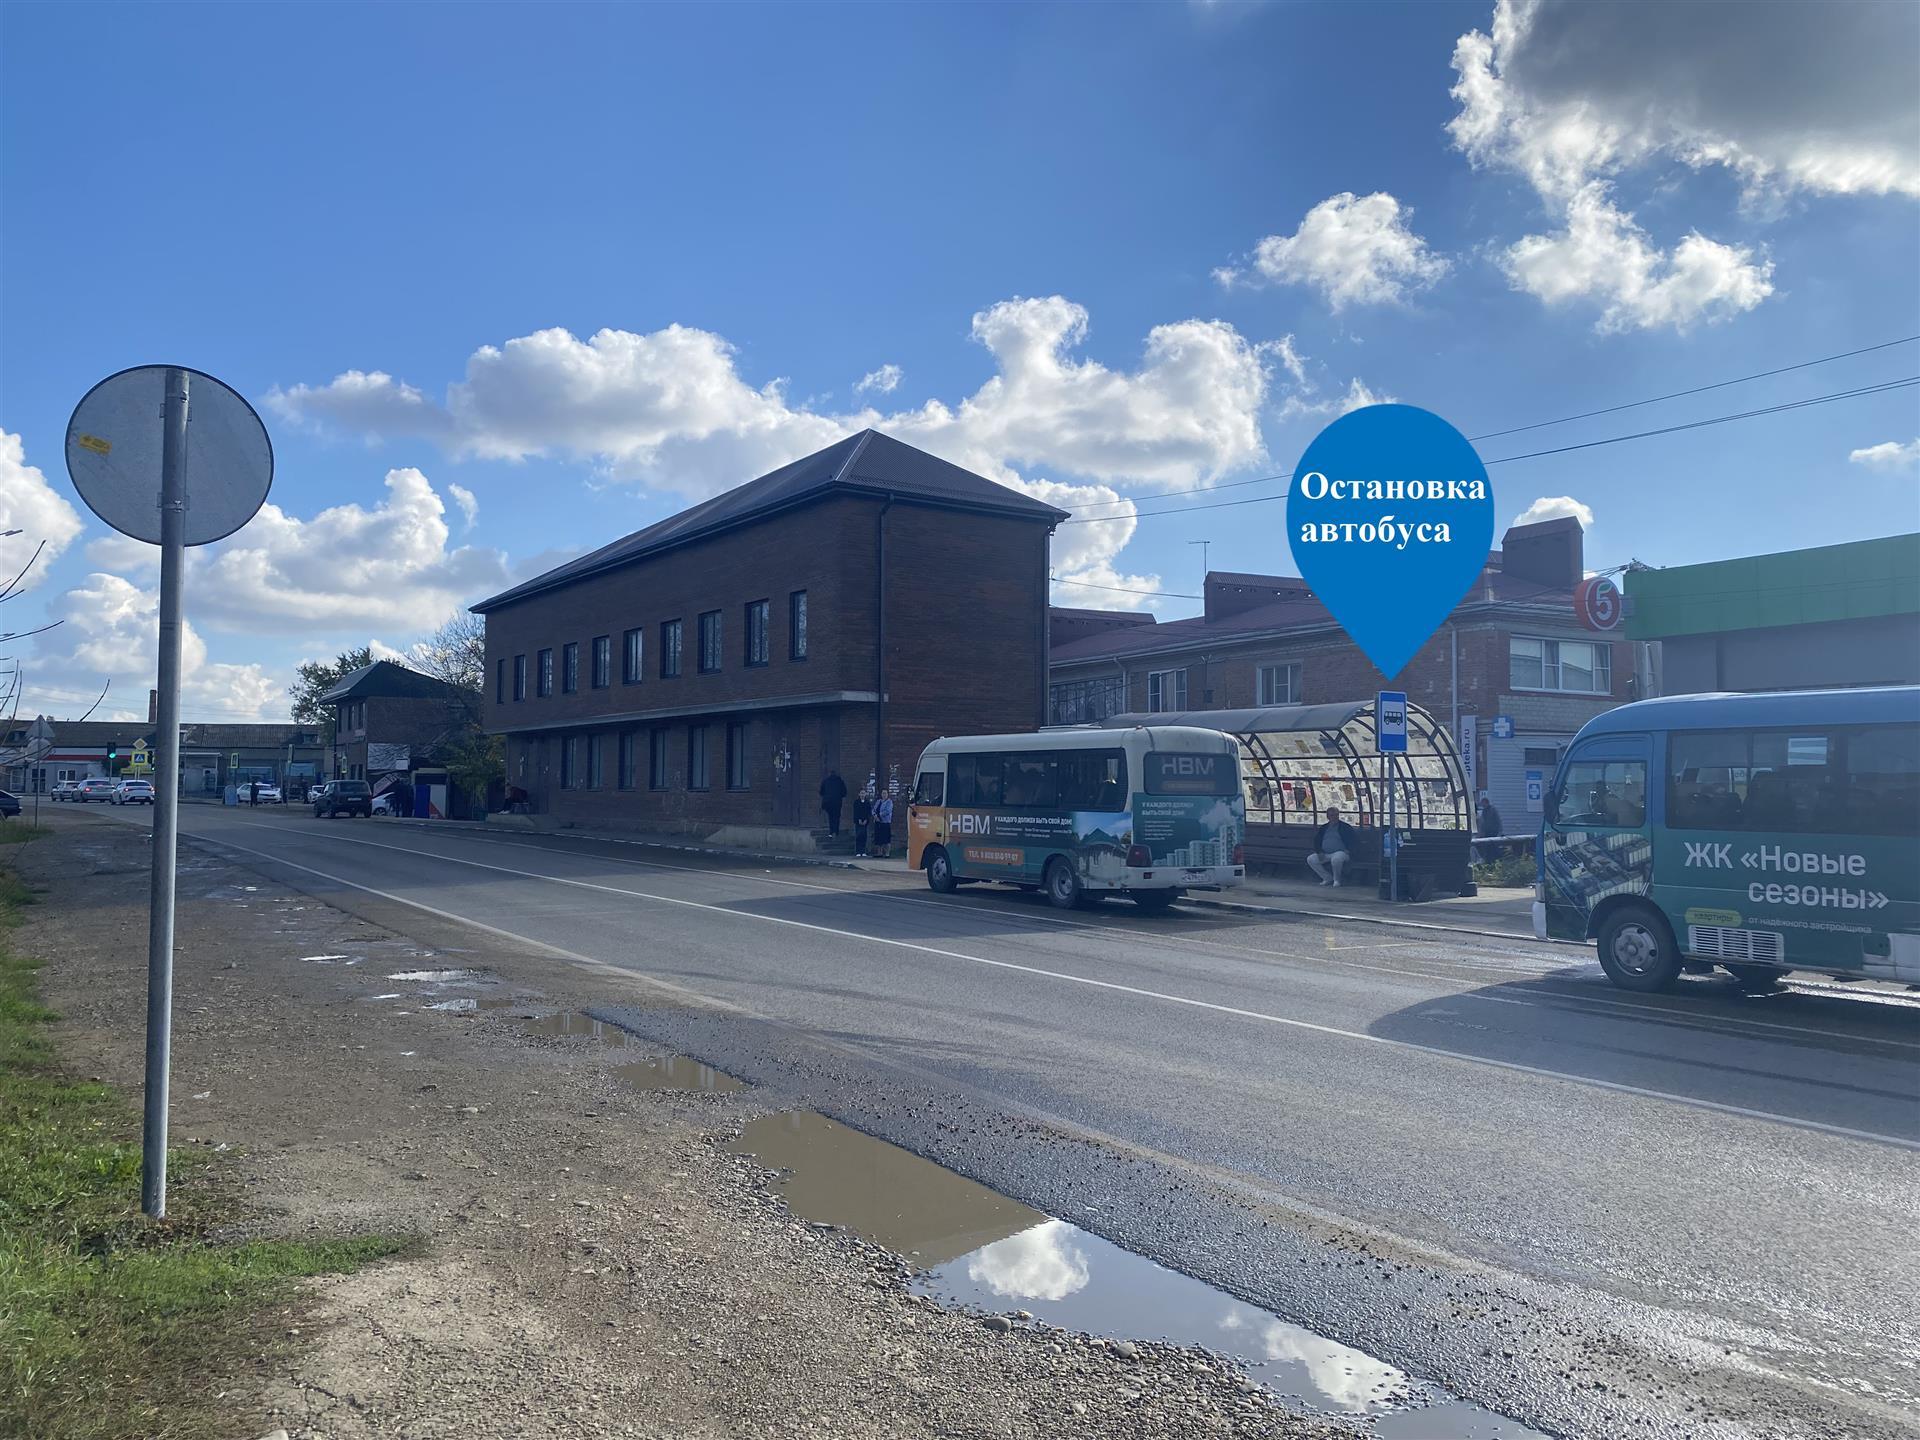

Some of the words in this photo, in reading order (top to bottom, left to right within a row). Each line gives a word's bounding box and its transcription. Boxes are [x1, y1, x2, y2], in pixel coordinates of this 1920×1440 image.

[1596, 582, 1613, 621] 5
[1161, 757, 1214, 775] НВМ
[949, 814, 991, 835] НВМ
[1684, 842, 1733, 869] ЖК
[1740, 845, 1866, 876] «Новые
[1748, 882, 1889, 909] сезоны»
